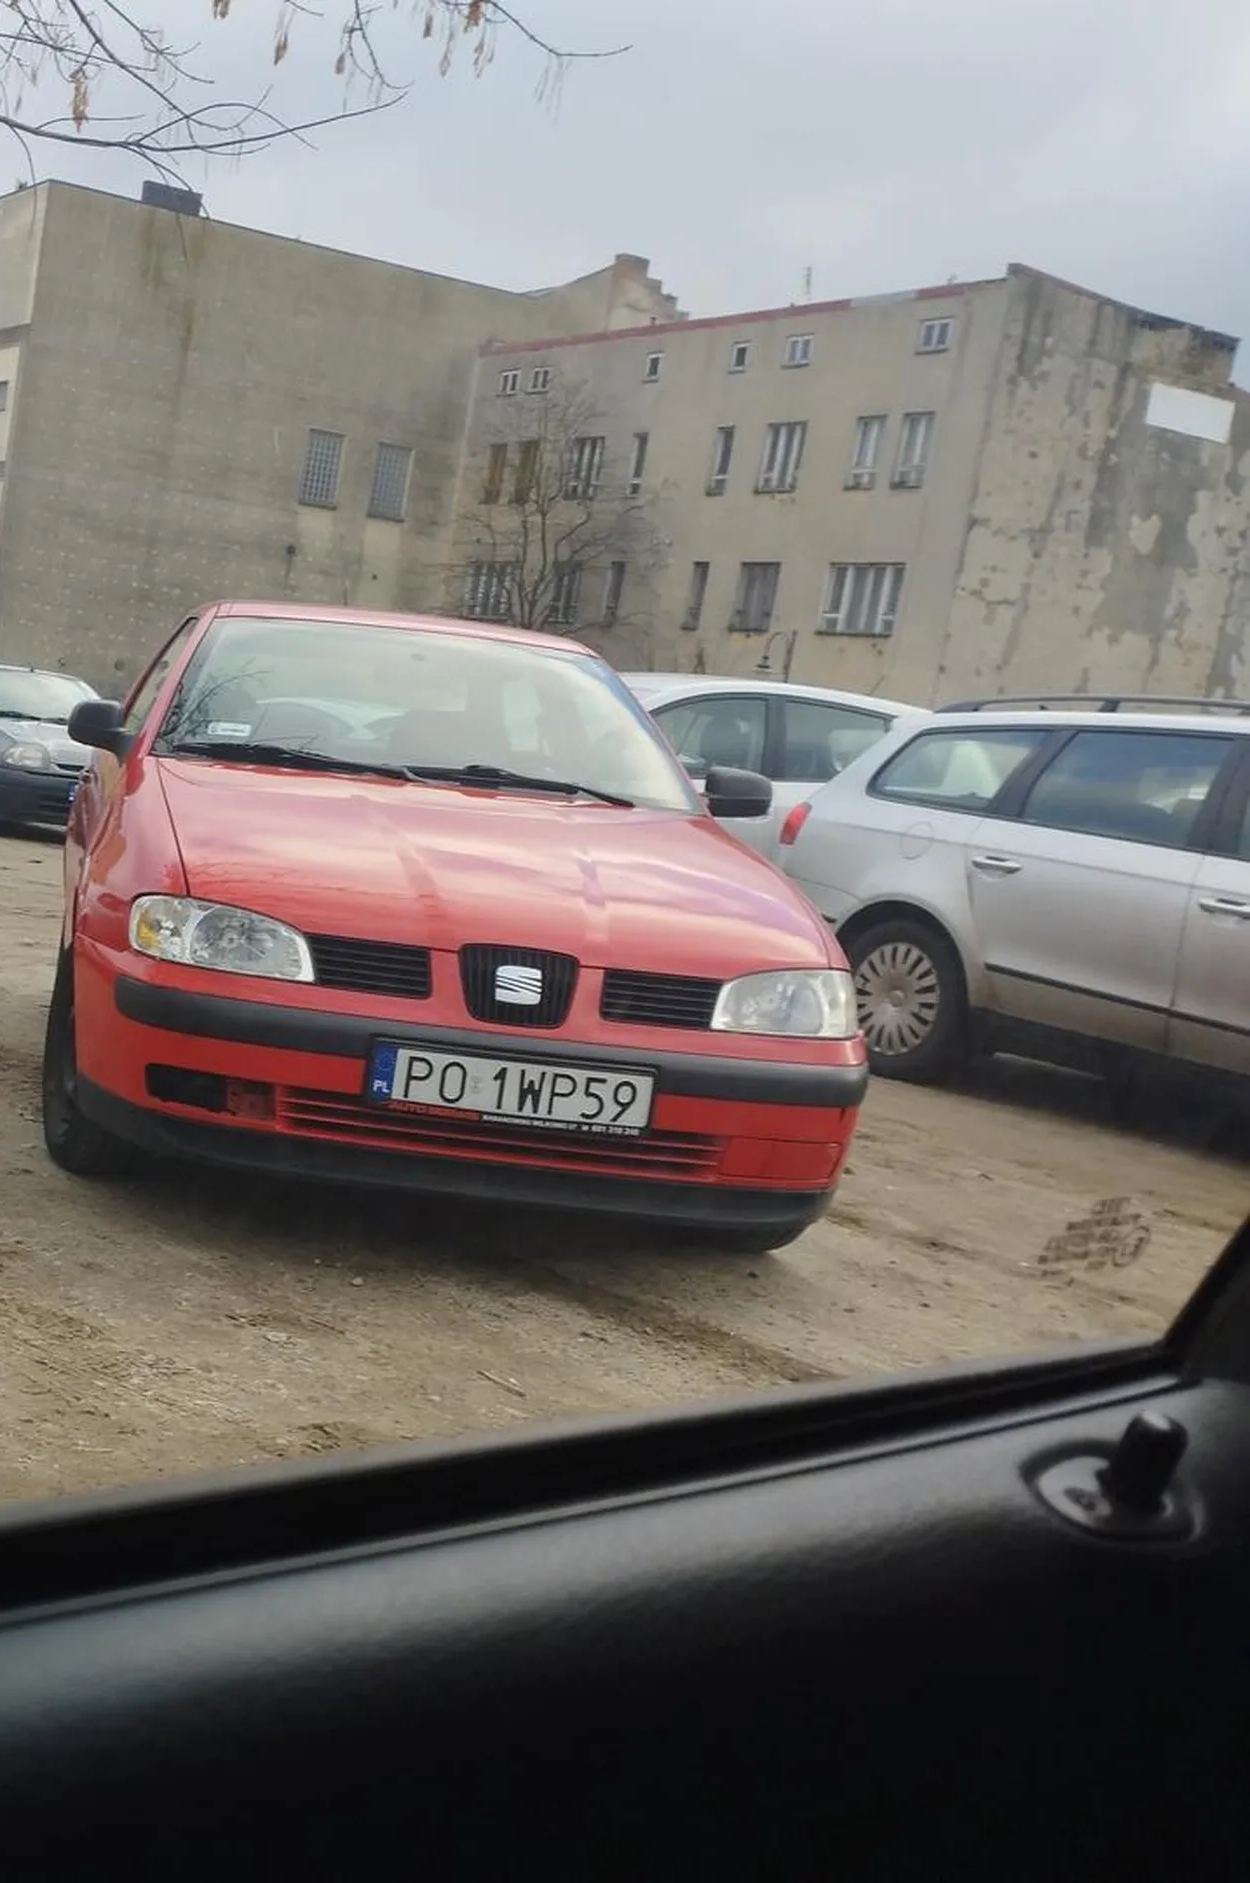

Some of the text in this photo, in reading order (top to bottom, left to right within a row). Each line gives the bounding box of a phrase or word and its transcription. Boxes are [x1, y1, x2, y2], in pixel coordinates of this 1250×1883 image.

[372, 1080, 390, 1094] PL
[403, 1056, 638, 1123] PO 1WP59
